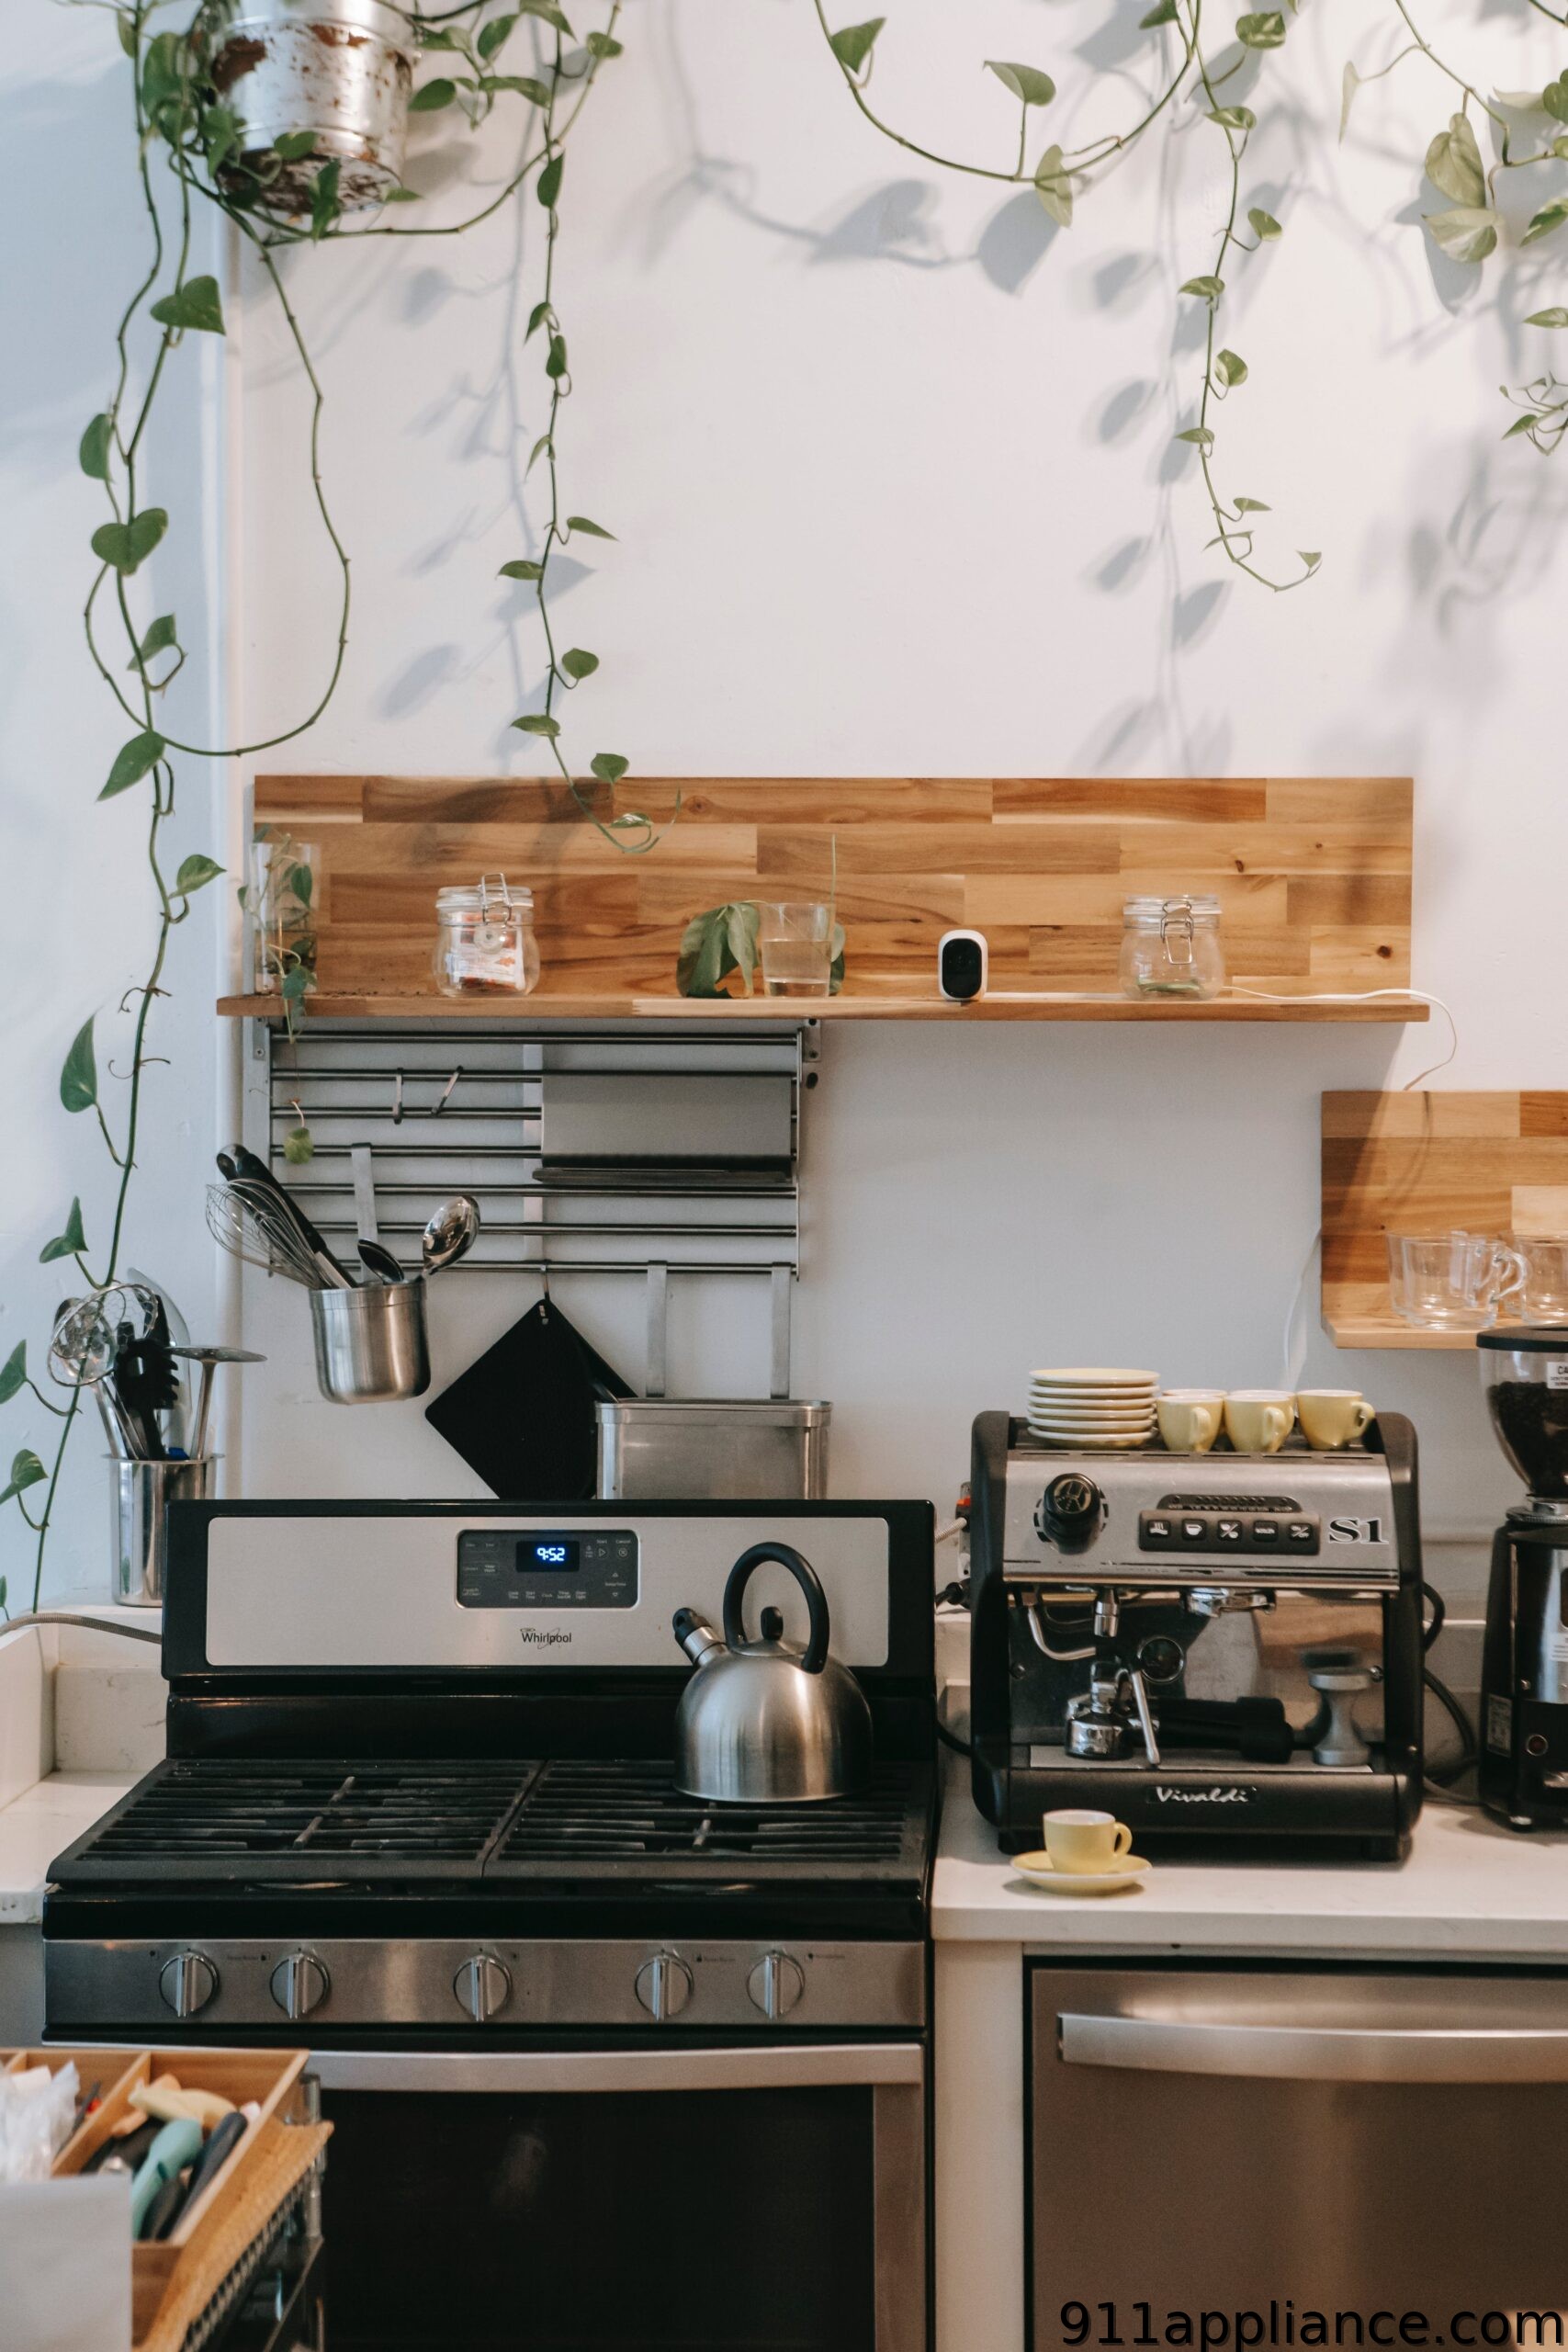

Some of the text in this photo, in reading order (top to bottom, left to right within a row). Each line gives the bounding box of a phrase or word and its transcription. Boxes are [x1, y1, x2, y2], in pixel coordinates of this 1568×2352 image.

[1328, 1517, 1389, 1545] S1
[536, 1547, 566, 1562] 9:52
[521, 1631, 572, 1645] Whirlpool
[1156, 1786, 1249, 1803] Vivaldi
